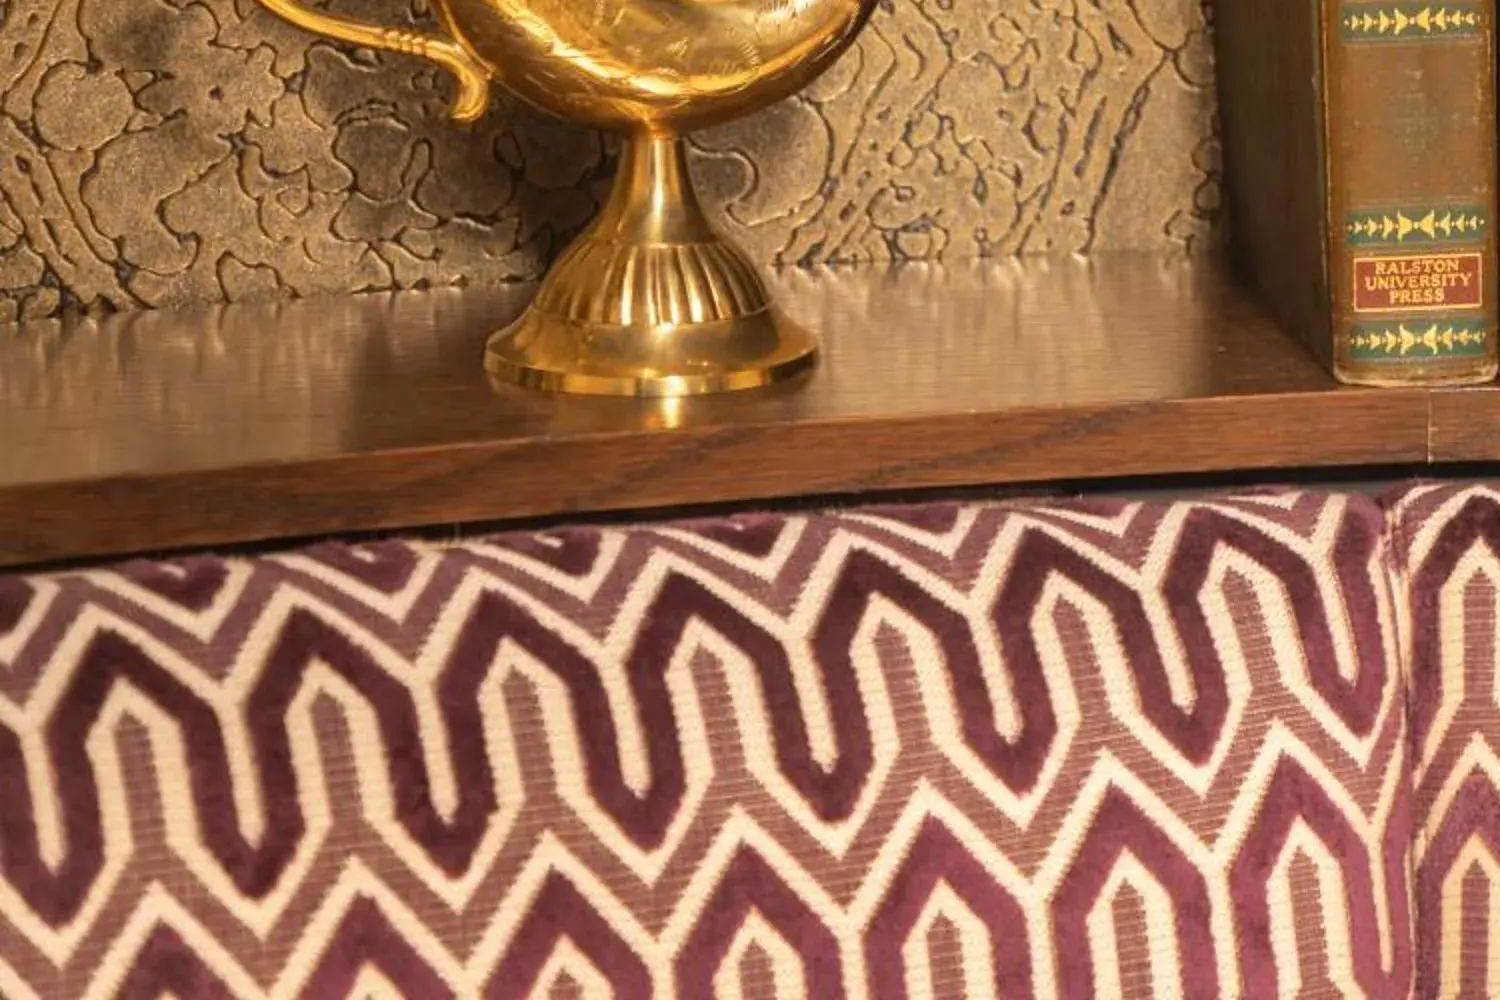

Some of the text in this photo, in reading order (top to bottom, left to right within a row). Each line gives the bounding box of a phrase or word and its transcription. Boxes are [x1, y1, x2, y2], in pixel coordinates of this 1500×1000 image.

[1375, 259, 1460, 275] RALSTON
[1364, 272, 1472, 291] UNIVERSITY
[1390, 288, 1444, 304] PRESS
